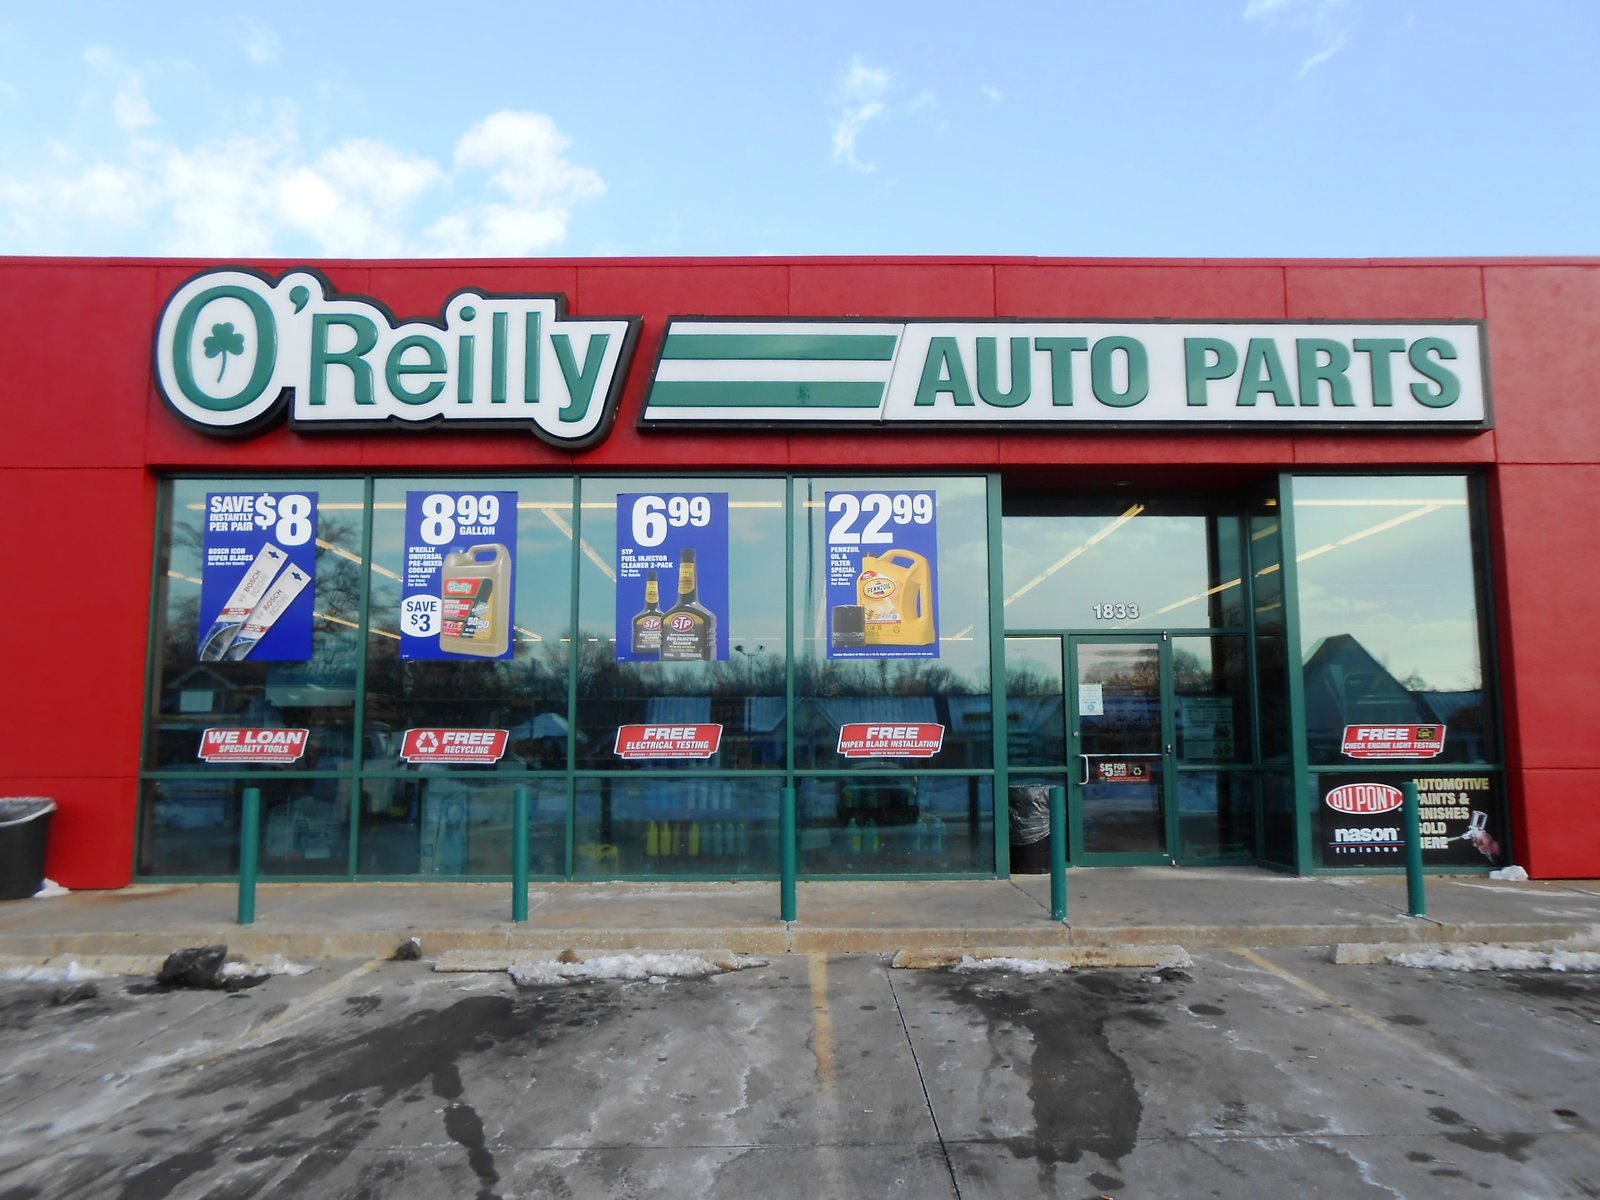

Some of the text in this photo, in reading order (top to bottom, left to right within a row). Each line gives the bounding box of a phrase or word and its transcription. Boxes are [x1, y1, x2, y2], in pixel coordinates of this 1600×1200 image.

[172, 284, 611, 423] O'Reilly
[913, 336, 1461, 408] AUTO PARTS
[210, 513, 254, 522] INSTANTLY
[211, 493, 312, 546] SAVE $8
[210, 522, 254, 532] PER PAIR
[460, 526, 495, 536] GALLON
[244, 570, 262, 592] BOSCH
[868, 583, 891, 593] PENNZOIL
[263, 588, 282, 610] BOSCH
[406, 601, 436, 612] SAVE
[1093, 603, 1140, 619] 1833
[411, 614, 430, 632] $3
[645, 620, 659, 628] STP
[674, 616, 691, 629] STP
[208, 731, 302, 744] WE LOAN
[442, 732, 496, 744] FREE
[643, 728, 697, 740] FREE
[866, 727, 919, 739] FREE
[1358, 729, 1409, 740] FREE
[264, 745, 288, 753] TOOLS
[445, 746, 489, 754] RECYCLING
[626, 741, 673, 749] ELECTRICAL
[1100, 763, 1113, 776] $5
[1459, 793, 1470, 805] &
[1334, 827, 1398, 842] nason
